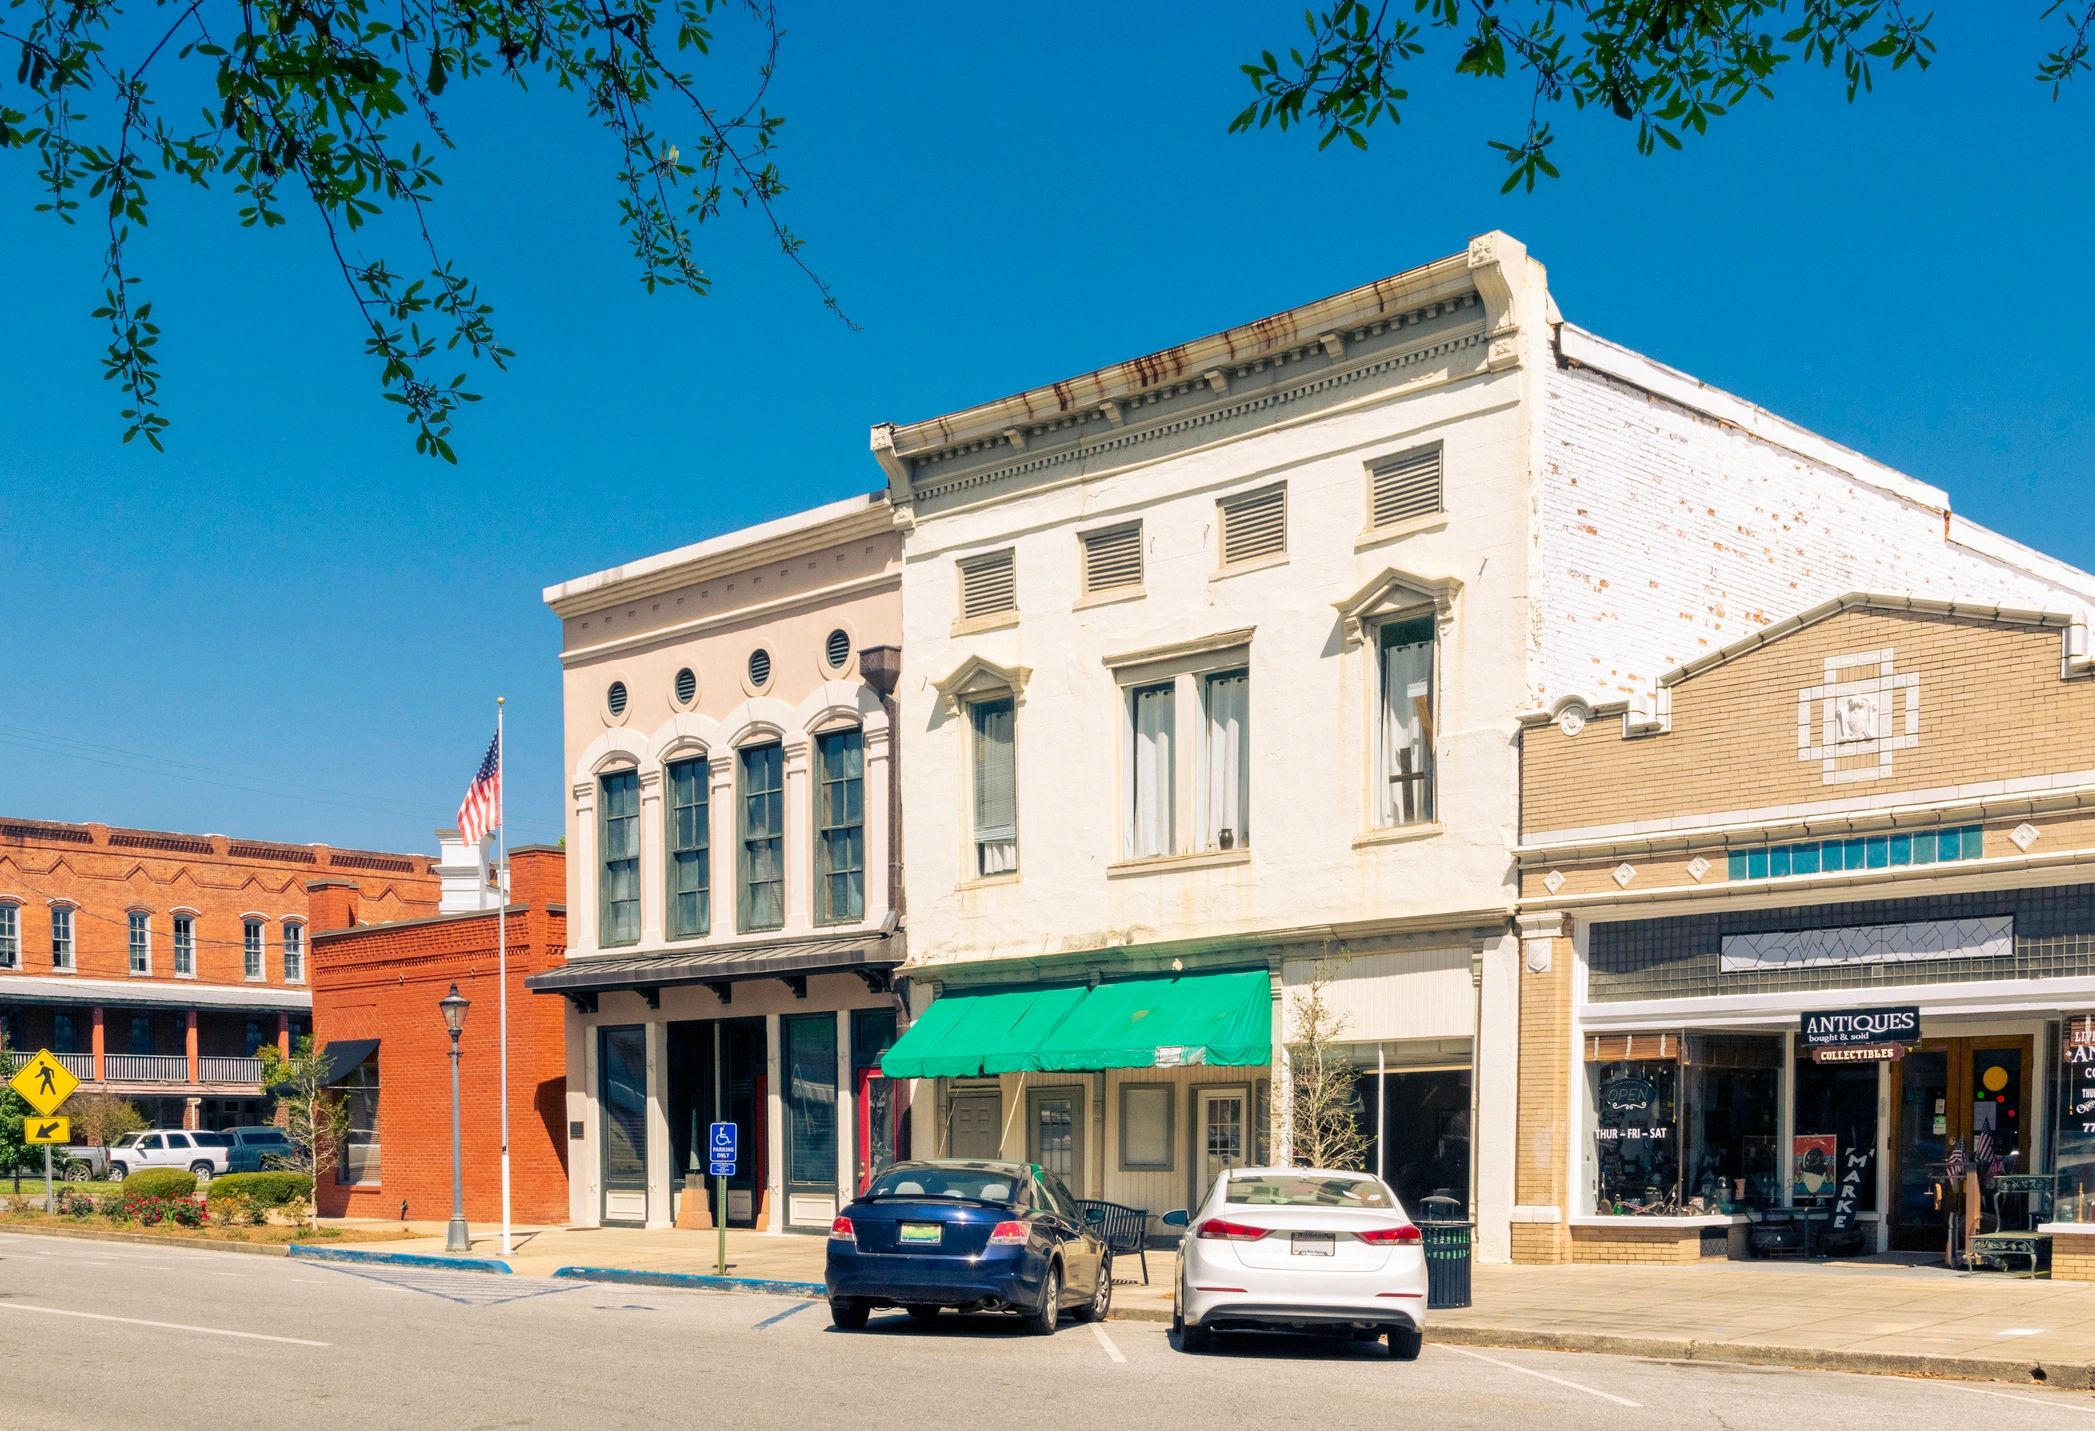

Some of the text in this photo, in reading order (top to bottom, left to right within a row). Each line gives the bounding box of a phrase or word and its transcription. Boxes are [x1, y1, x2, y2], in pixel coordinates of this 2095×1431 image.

[1807, 1013, 1915, 1033] ANTIQUES
[1808, 1032, 1869, 1043] bought & sold
[1820, 1048, 1894, 1061] COLLECTIBLES
[1608, 1087, 1649, 1101] OPEN
[1595, 1128, 1618, 1139] THUR
[1627, 1128, 1640, 1139] FRI
[1650, 1127, 1667, 1138] SAT
